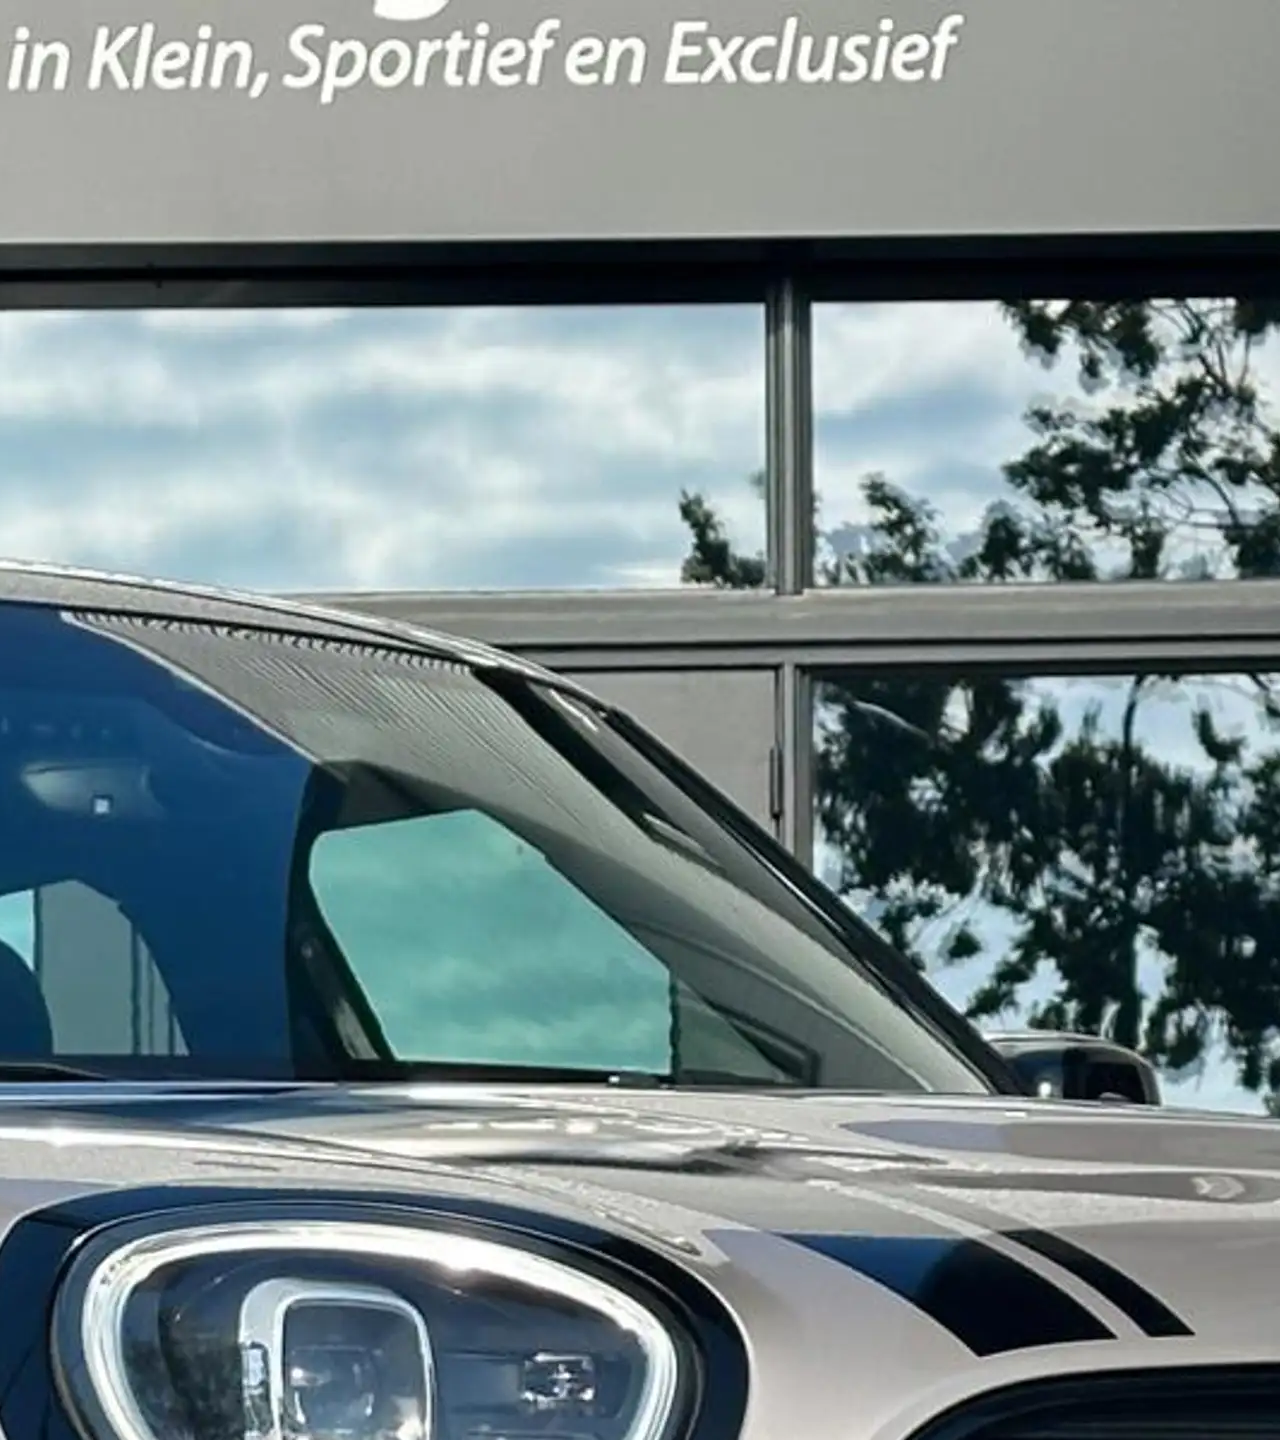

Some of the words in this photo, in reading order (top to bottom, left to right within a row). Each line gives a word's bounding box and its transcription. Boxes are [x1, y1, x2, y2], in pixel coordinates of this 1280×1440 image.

[7, 26, 70, 91] in
[88, 22, 269, 98] Klein,
[282, 18, 561, 104] Sportief
[565, 37, 646, 85] en
[664, 14, 964, 84] Exclusief
